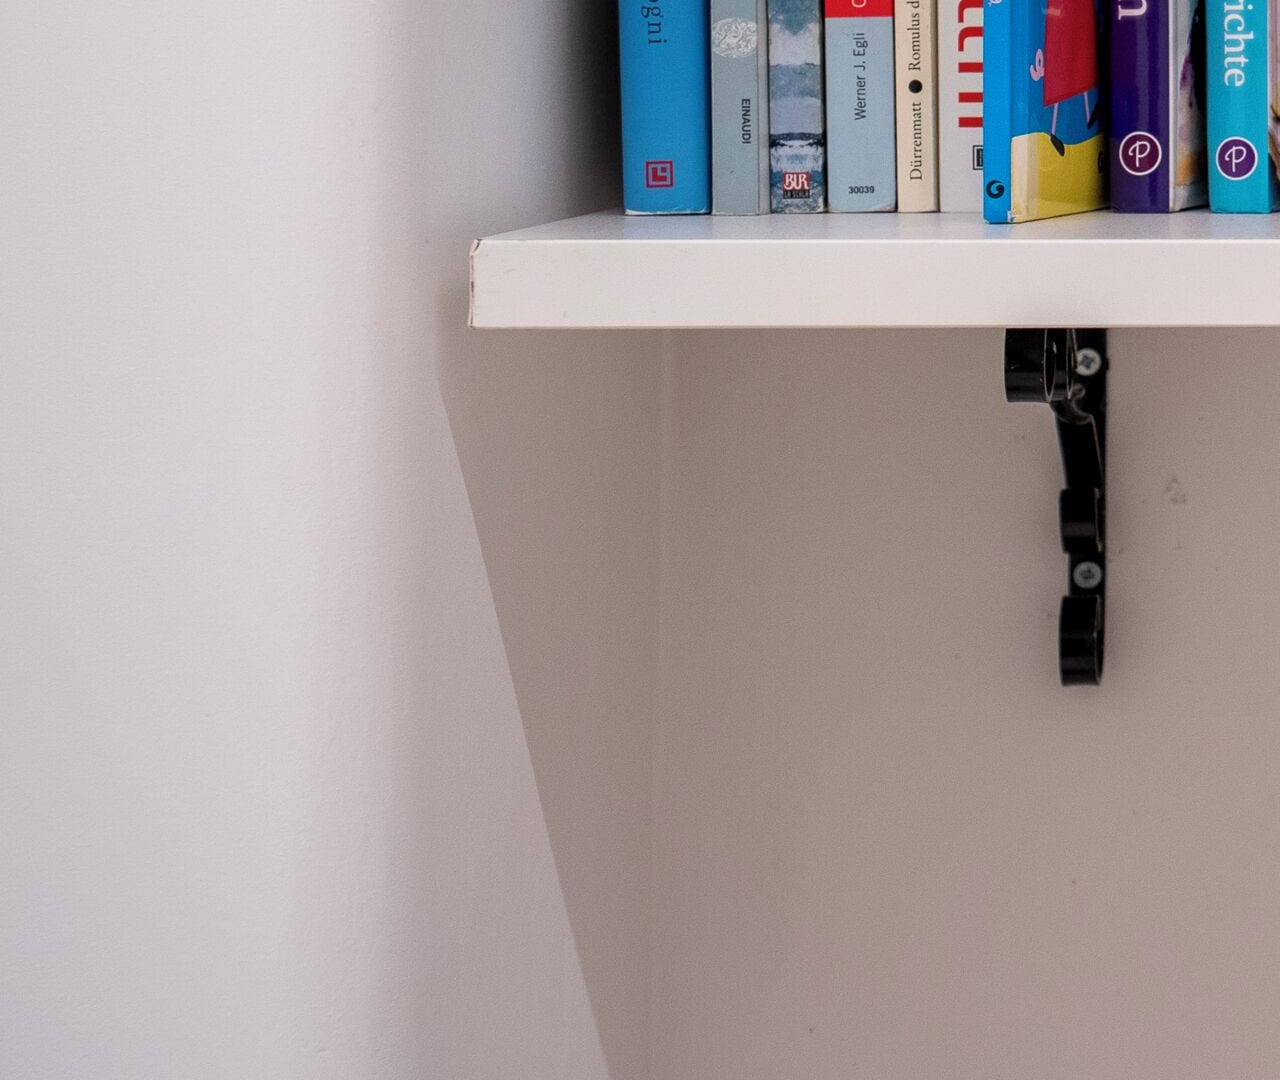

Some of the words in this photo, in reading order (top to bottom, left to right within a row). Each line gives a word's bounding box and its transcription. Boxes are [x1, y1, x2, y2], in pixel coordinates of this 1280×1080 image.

[852, 32, 869, 57] Egli
[906, 13, 921, 71] Romulus
[853, 60, 866, 71] J.
[854, 75, 867, 121] Werner
[741, 98, 752, 144] EINAUDI
[910, 102, 923, 181] Dürrenmatt
[783, 173, 809, 191] BUR
[848, 185, 875, 194] 30039
